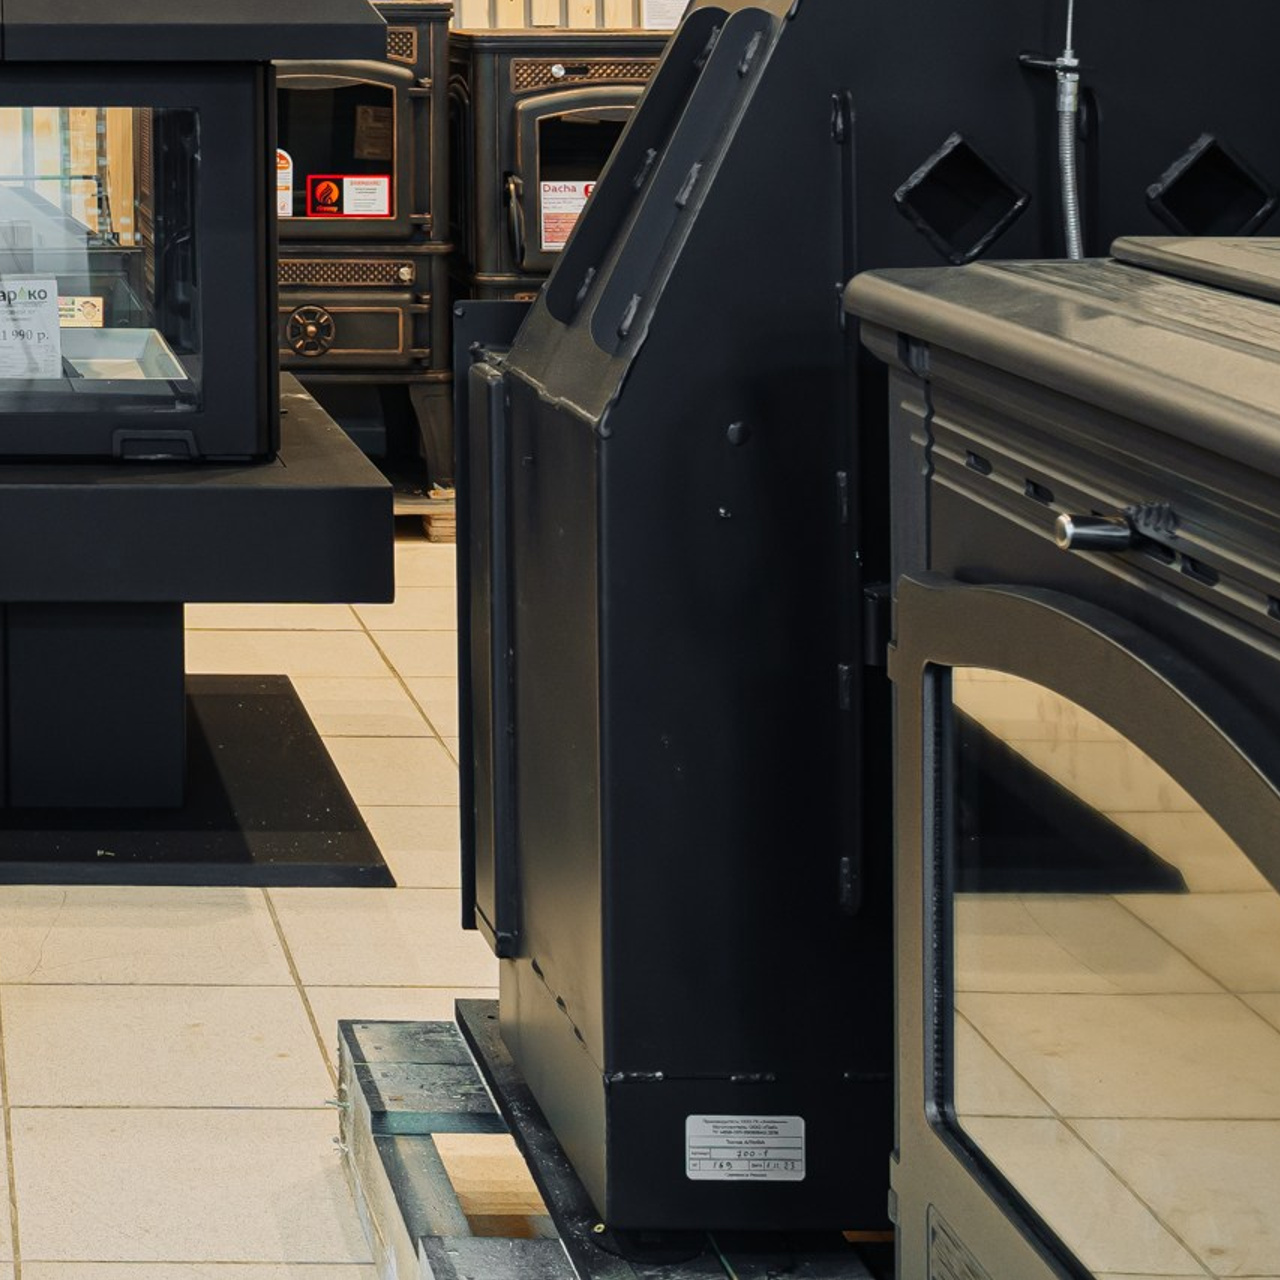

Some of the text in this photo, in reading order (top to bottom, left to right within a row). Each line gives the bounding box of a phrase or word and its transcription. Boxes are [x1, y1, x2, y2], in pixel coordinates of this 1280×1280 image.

[542, 183, 577, 193] Dacha
[11, 329, 33, 340] 990
[37, 331, 49, 343] р.
